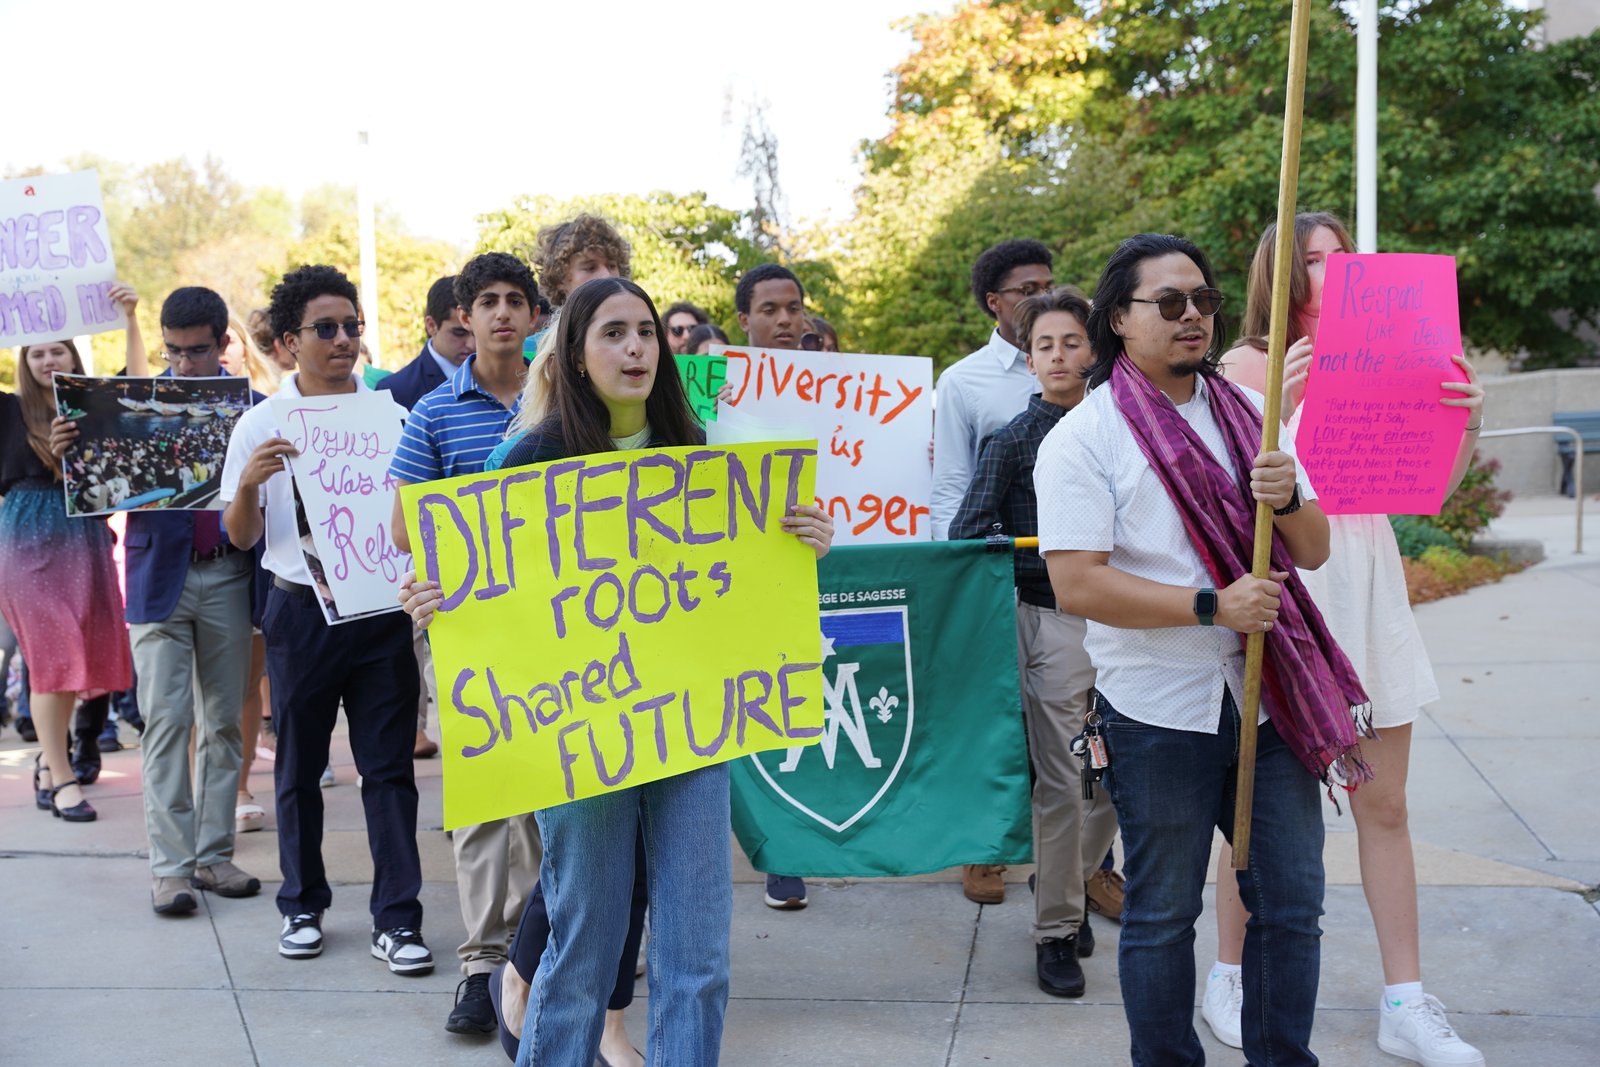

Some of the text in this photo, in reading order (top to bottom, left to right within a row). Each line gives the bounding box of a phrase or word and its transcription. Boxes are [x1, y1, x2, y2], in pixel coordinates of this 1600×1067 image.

[24, 185, 36, 197] a
[1319, 351, 1348, 372] not
[1354, 347, 1386, 374] the
[722, 350, 923, 425] Diversity
[1351, 399, 1361, 411] to
[1363, 401, 1385, 416] you
[1387, 399, 1412, 411] who
[1413, 398, 1437, 413] are
[1375, 412, 1382, 423] I
[287, 405, 392, 460] Jesus
[1313, 425, 1350, 441] LOVE
[1350, 431, 1378, 448] your
[1308, 443, 1430, 460] do good to those who
[1305, 457, 1336, 470] hate
[1363, 457, 1393, 469] bless
[1396, 457, 1432, 469] those
[308, 458, 378, 496] Was
[1310, 473, 1327, 485] ho
[1323, 485, 1358, 496] those
[1360, 486, 1384, 496] who
[1387, 485, 1436, 496] mistreat
[418, 449, 818, 613] DIFFERENT
[551, 560, 733, 639] roots
[839, 592, 856, 603] DE
[856, 588, 906, 602] SAGESSE
[451, 632, 642, 758] Shared
[557, 662, 825, 800] FUTURE
